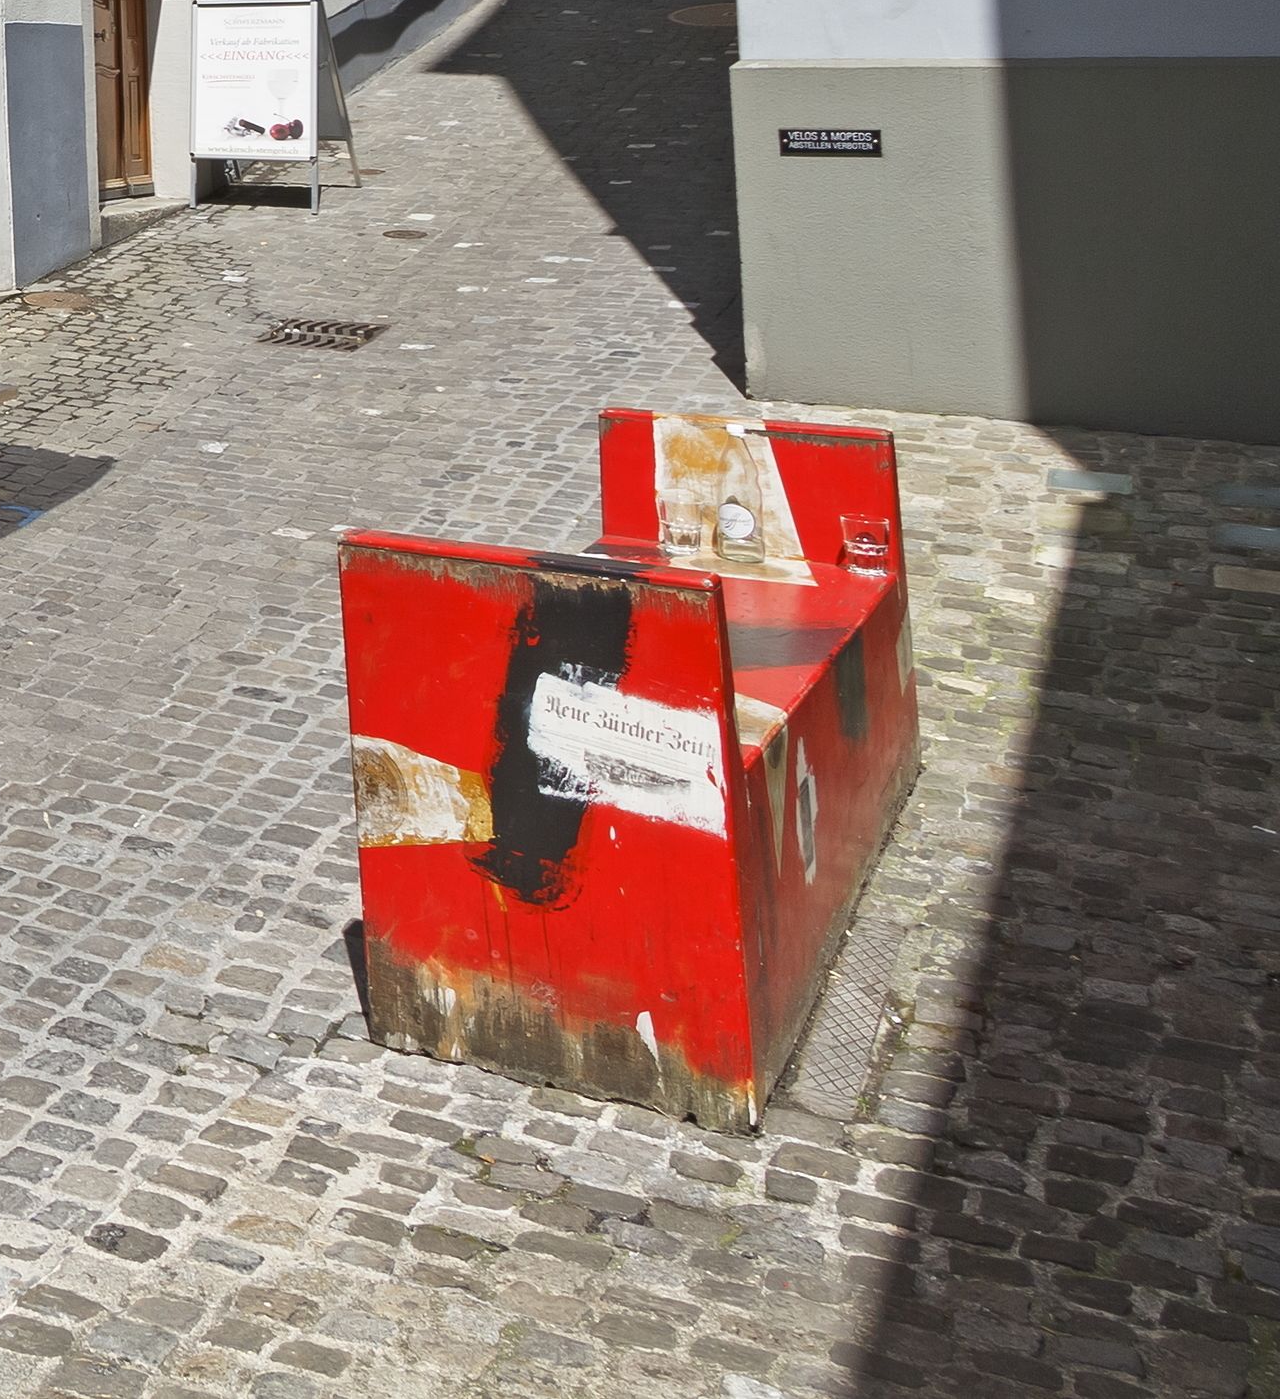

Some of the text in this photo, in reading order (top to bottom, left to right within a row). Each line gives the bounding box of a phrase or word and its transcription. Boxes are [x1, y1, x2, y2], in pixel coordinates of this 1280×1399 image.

[788, 131, 872, 142] VELOS & MOPEDS
[788, 141, 873, 151] ABSTELLEN VERBOTEN
[544, 694, 590, 723] Neue
[592, 709, 665, 745] Zürcher
